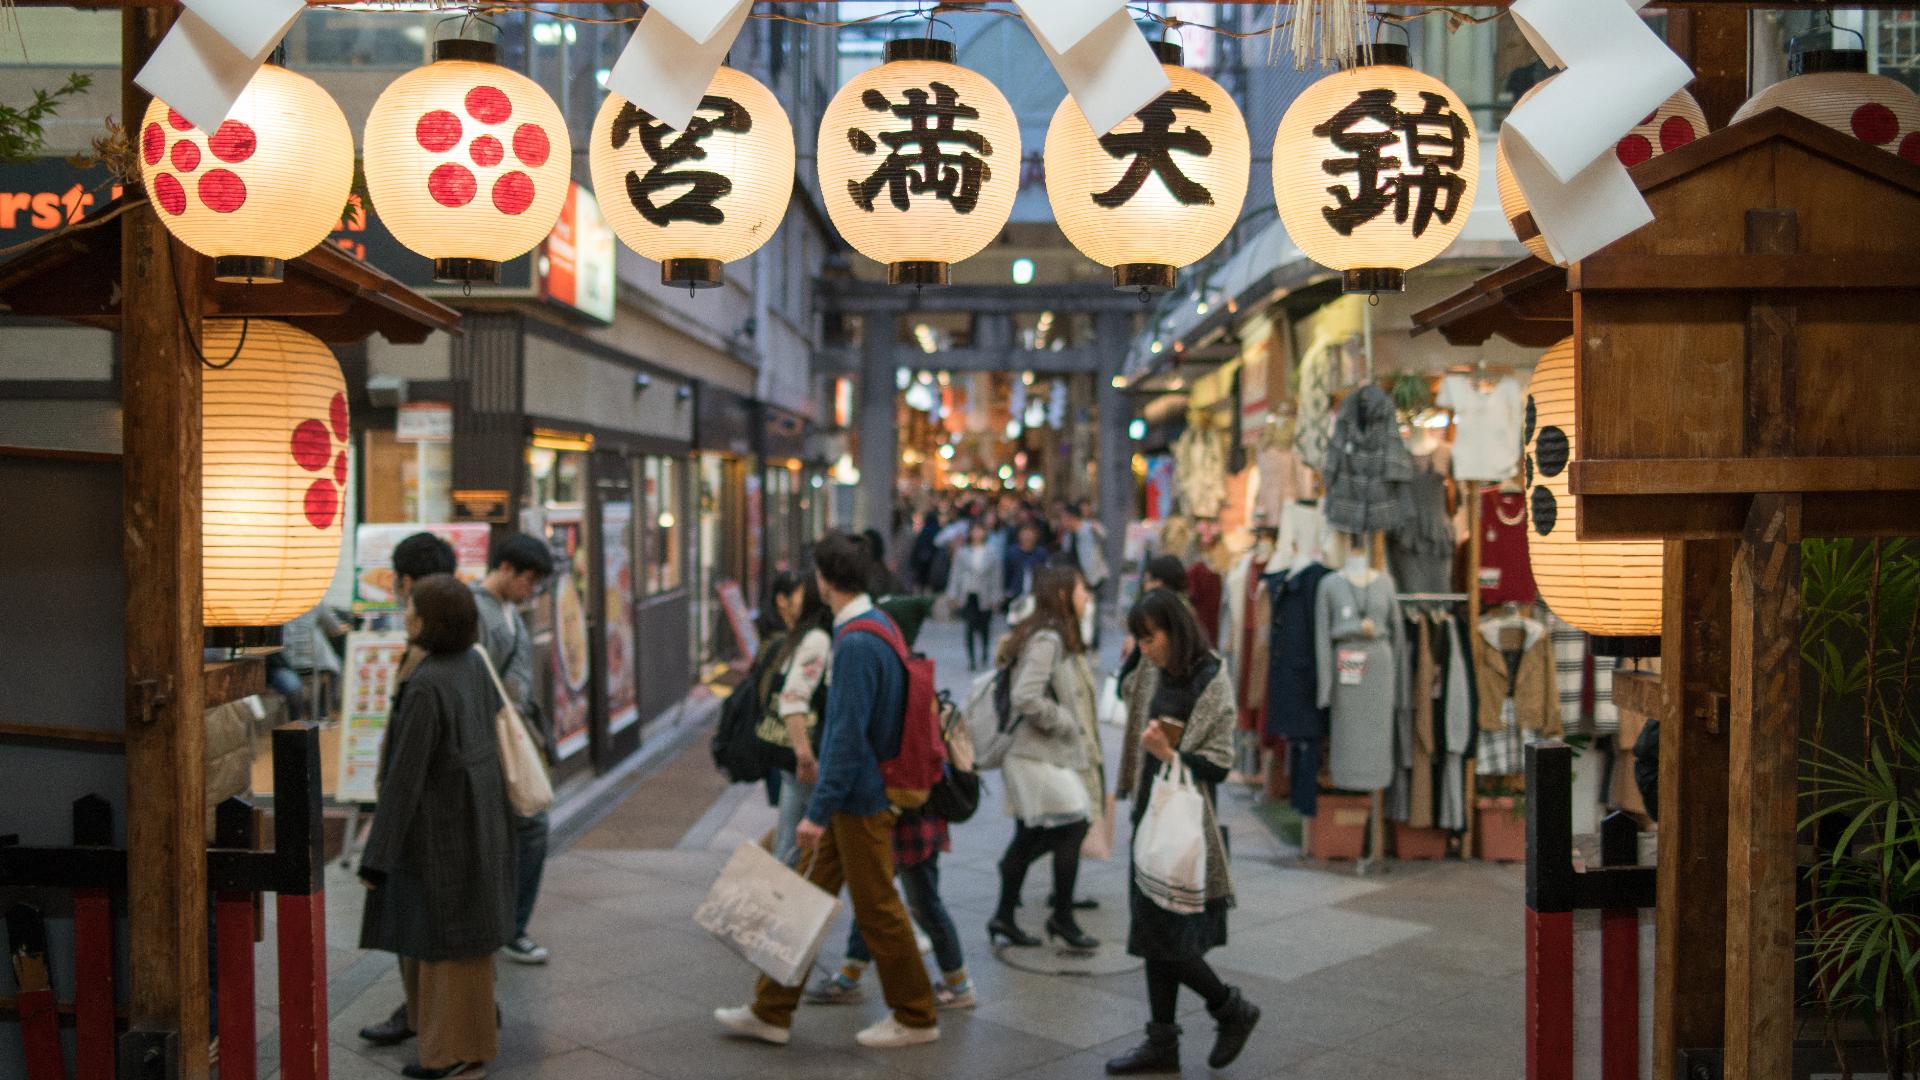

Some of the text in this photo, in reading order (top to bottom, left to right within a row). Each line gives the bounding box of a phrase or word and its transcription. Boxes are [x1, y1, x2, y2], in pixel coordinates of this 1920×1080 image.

[848, 82, 991, 213] 満
[1091, 89, 1215, 208] 天
[1314, 88, 1470, 237] 錦
